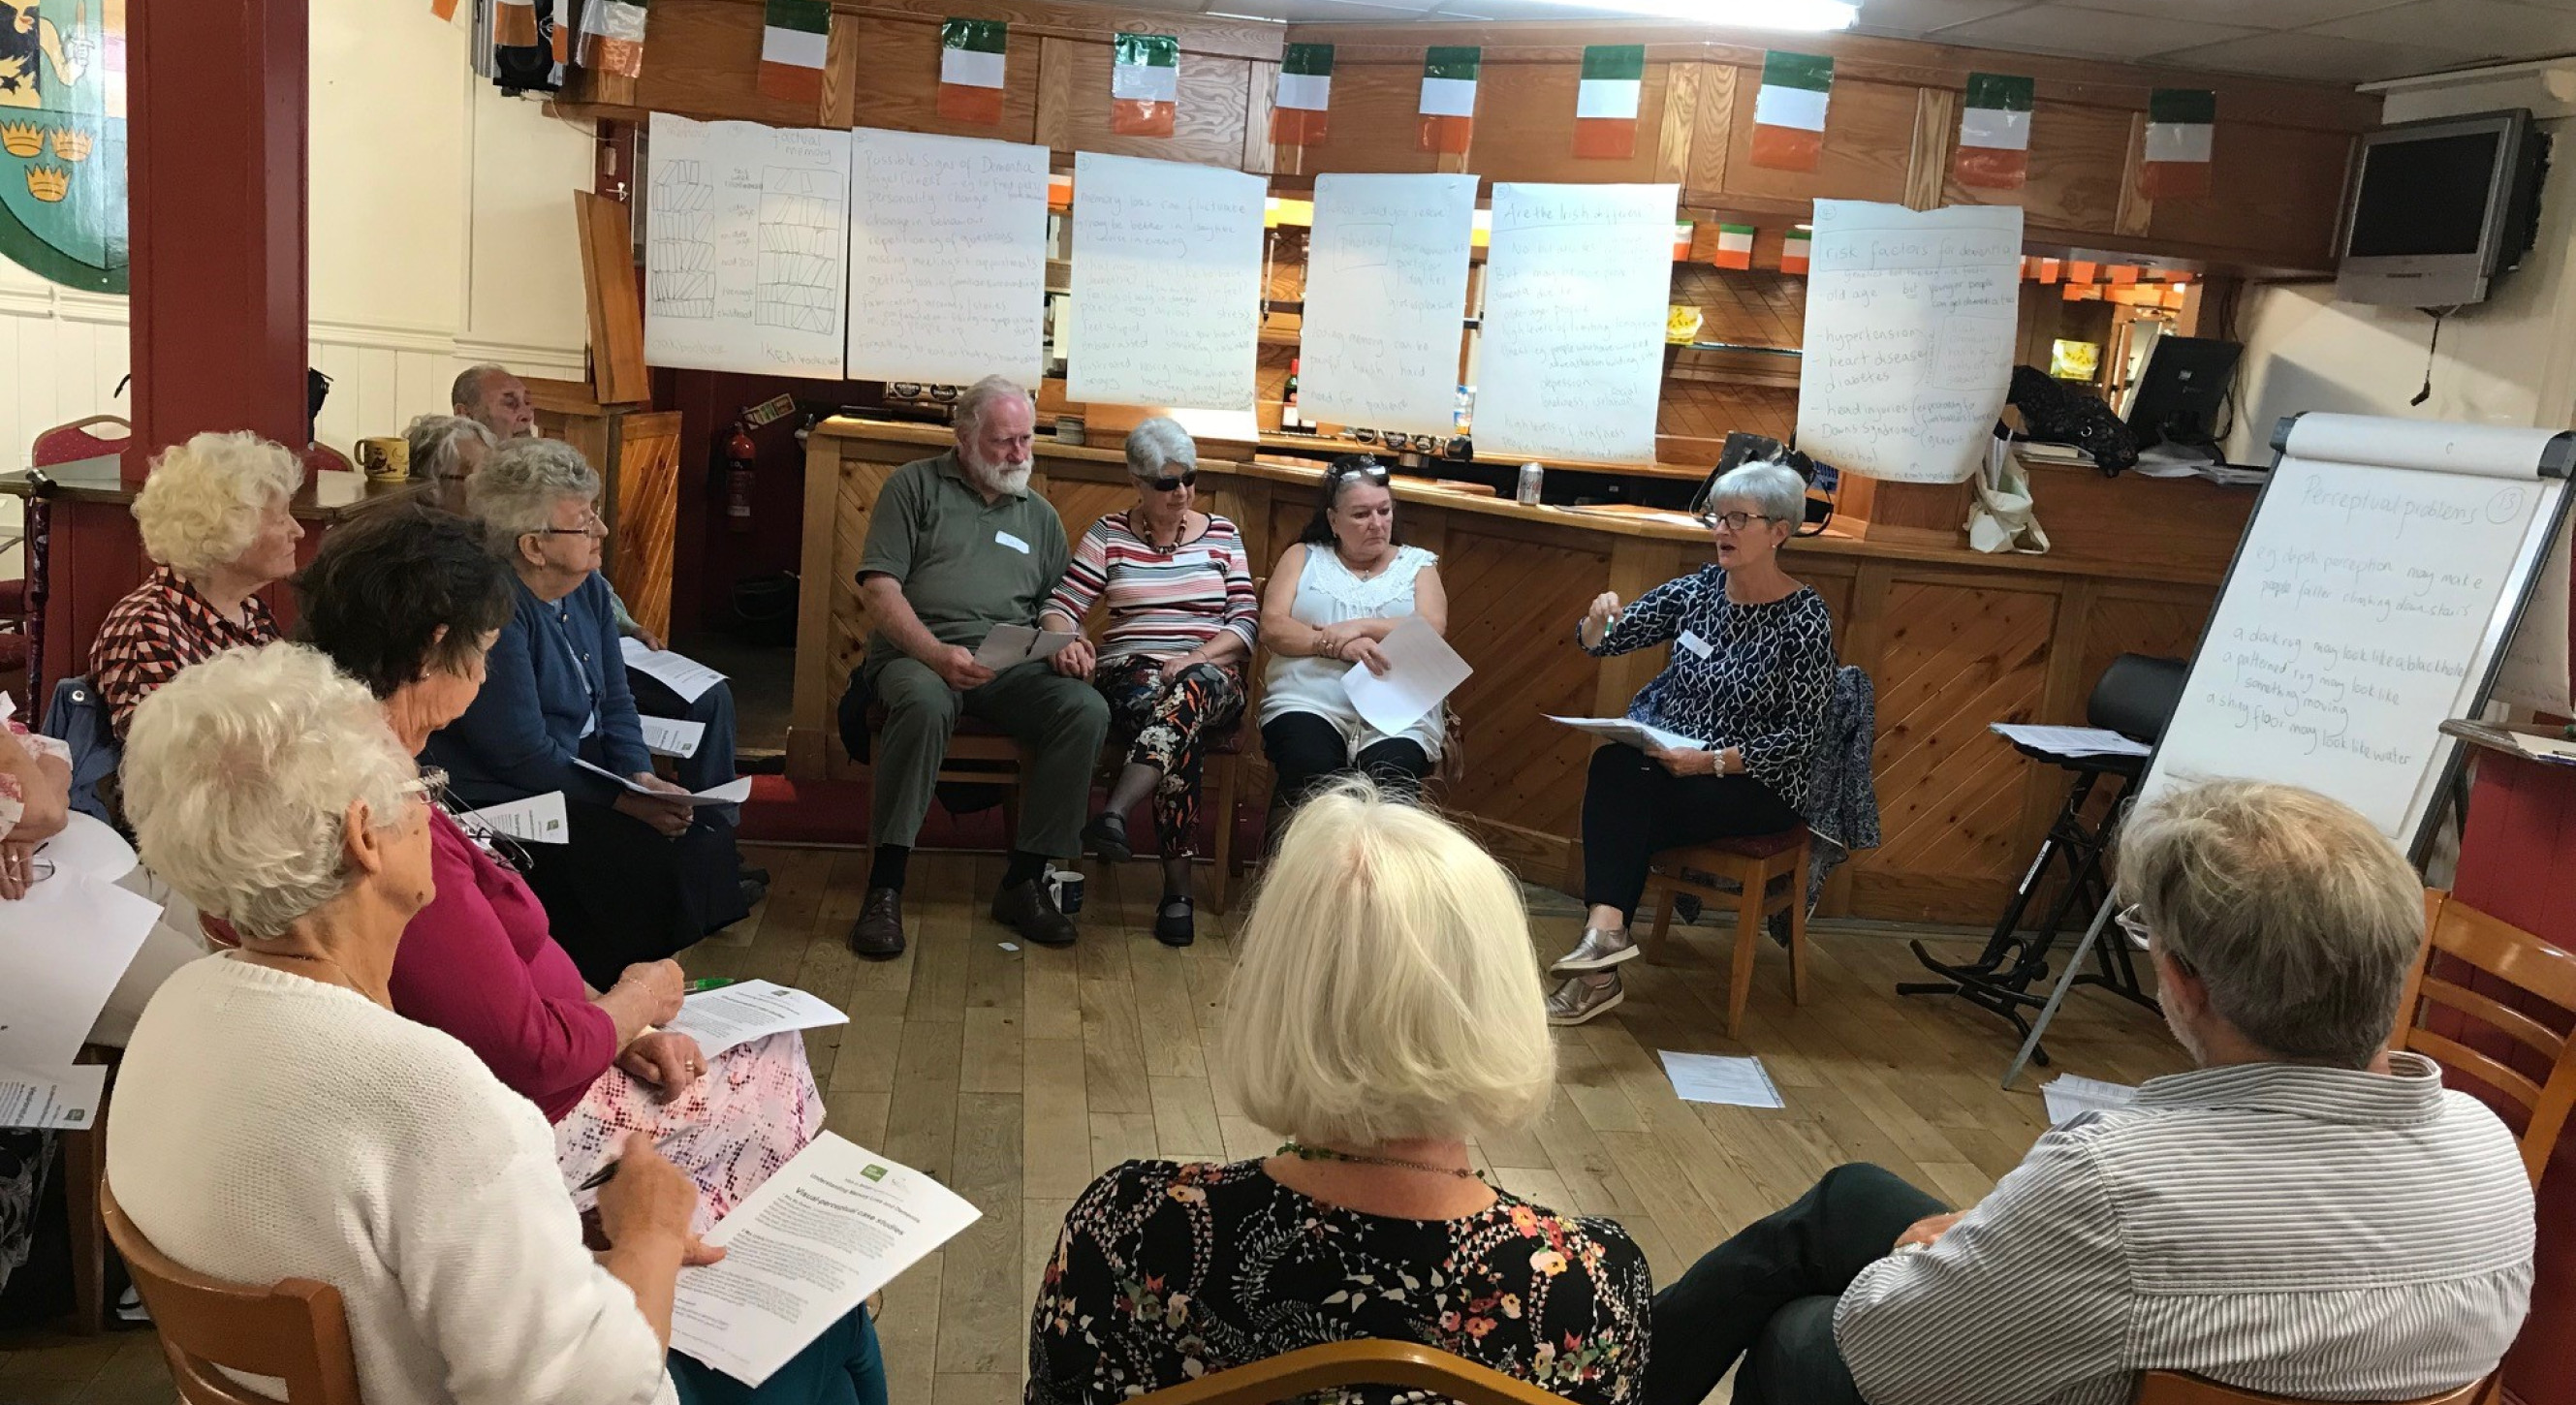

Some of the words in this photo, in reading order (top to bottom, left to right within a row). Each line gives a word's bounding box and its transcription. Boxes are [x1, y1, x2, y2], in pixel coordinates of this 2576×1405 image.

[784, 145, 832, 166] memory
[864, 149, 915, 168] Possible
[923, 154, 955, 175] Signs
[959, 156, 971, 178] of
[982, 155, 1037, 174] Dementia
[947, 190, 989, 209] change
[1129, 195, 1152, 207] loss
[1187, 197, 1246, 222] fluctuate
[930, 213, 985, 226] behaviour
[1131, 219, 1164, 232] better
[1504, 203, 1533, 225] Are
[1535, 205, 1553, 220] the
[1559, 203, 1588, 221] Irish
[959, 231, 1015, 248] questions
[1145, 237, 1188, 259] evening
[1340, 233, 1381, 257] photos
[866, 254, 907, 275] missing
[1826, 243, 1859, 261] risk
[1870, 239, 1929, 270] factors
[1959, 239, 2011, 258] dementia
[867, 274, 914, 294] getting
[1826, 289, 1846, 302] old
[1852, 289, 1879, 308] age
[1902, 282, 1919, 295] but
[1929, 280, 1963, 298] younger
[1968, 278, 1995, 294] people
[1349, 332, 1385, 358] memory
[1826, 326, 1916, 351] hypertension
[761, 341, 795, 364] IKEA
[1829, 351, 1869, 368] heart
[1874, 349, 1927, 367] disease
[1399, 358, 1426, 377] hard
[1825, 371, 1890, 394] diabetes
[1827, 398, 1860, 416] head
[1865, 404, 1907, 422] injuries
[1822, 423, 1858, 438] Downs
[1825, 448, 1878, 461] alcohol
[2301, 474, 2399, 525] Perceptual
[2396, 499, 2478, 539] problems
[2256, 546, 2277, 572] eg
[2282, 546, 2318, 579] depth
[2323, 557, 2393, 584] perception
[2406, 566, 2435, 597] may
[2440, 572, 2483, 590] make
[2261, 579, 2292, 599] people
[2342, 593, 2391, 623] climbing
[2233, 627, 2244, 640] a
[2248, 625, 2278, 644] dark
[2281, 637, 2303, 664] rug
[2313, 641, 2339, 671] may
[2342, 644, 2368, 662] look
[2371, 650, 2394, 668] like
[2395, 657, 2406, 671] a
[2406, 655, 2440, 673] black
[2441, 660, 2465, 678] hole
[2221, 650, 2233, 664] a
[2236, 651, 2288, 683] patterned
[2293, 668, 2314, 694] rug
[2318, 676, 2345, 703] may
[2351, 675, 2376, 698] look
[2377, 689, 2401, 706] like
[2244, 675, 2300, 717] something
[2303, 696, 2349, 739] moving
[2206, 692, 2216, 703] a
[2218, 692, 2249, 729] shiny
[2253, 704, 2285, 733] floor
[2288, 723, 2318, 756] may
[2322, 731, 2347, 750] look
[2351, 738, 2371, 759] like
[2372, 745, 2412, 765] water
[858, 1210, 876, 1221] case
[877, 1218, 904, 1236] studies
